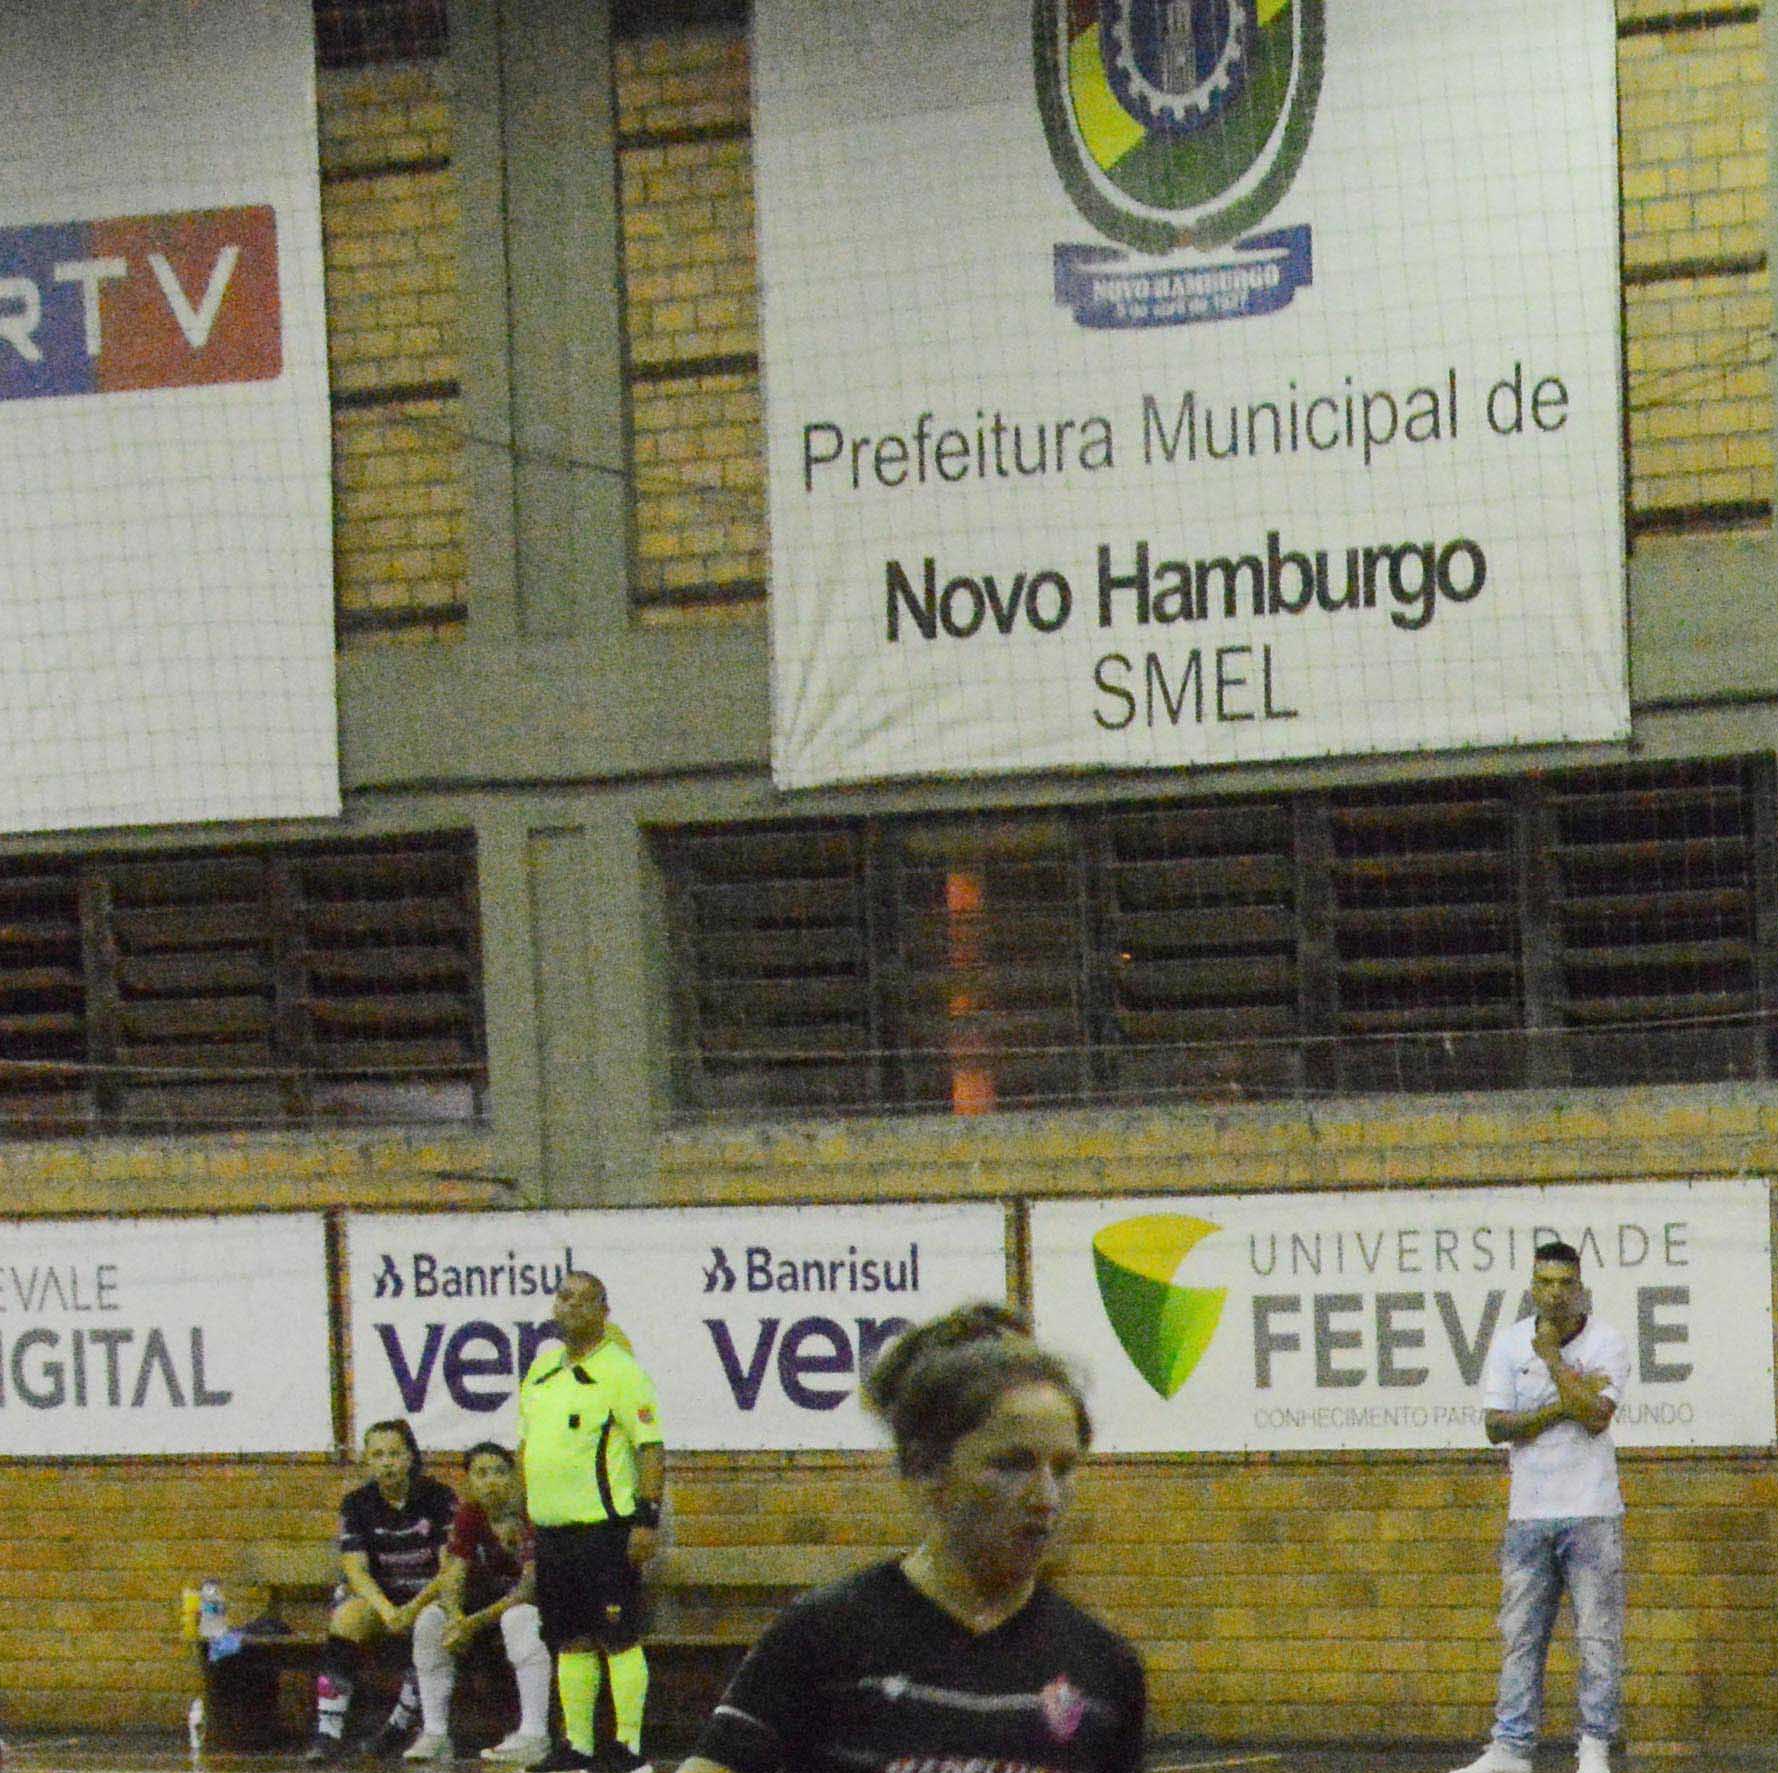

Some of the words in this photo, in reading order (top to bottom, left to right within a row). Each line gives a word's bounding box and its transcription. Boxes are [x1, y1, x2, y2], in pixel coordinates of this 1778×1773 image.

[803, 411, 1114, 492] Prefeitura
[1142, 366, 1459, 465] Municipal
[1487, 362, 1570, 433] de
[885, 558, 1072, 643] Novo
[1097, 531, 1487, 629] Hamburgo
[1092, 645, 1299, 731] SMEL
[746, 1242, 919, 1293] Banrisul
[373, 1318, 566, 1413] ver
[702, 1315, 916, 1411] ver
[1253, 1286, 1694, 1389] FEEVE
[1253, 1407, 1428, 1430] CONHECIMENTO
